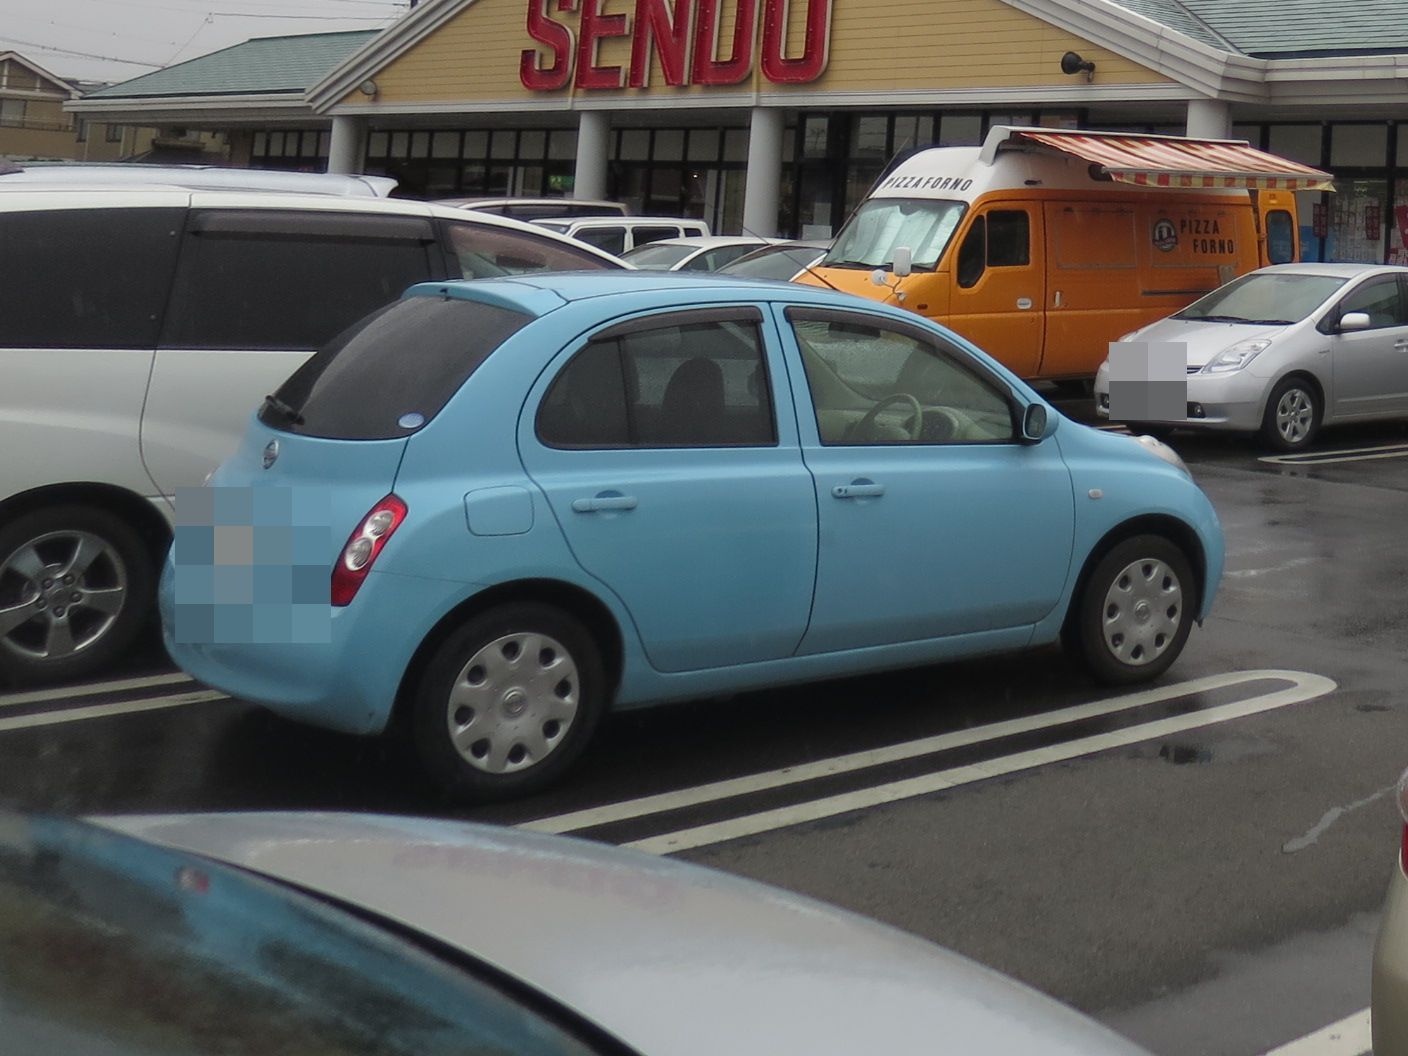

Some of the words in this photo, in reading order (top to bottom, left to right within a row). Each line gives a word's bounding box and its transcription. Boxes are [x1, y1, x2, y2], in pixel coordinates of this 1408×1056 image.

[882, 176, 924, 189] PIZZA
[922, 176, 973, 192] FORNO
[1180, 219, 1220, 235] PIZZA
[1193, 238, 1235, 255] FORNO
